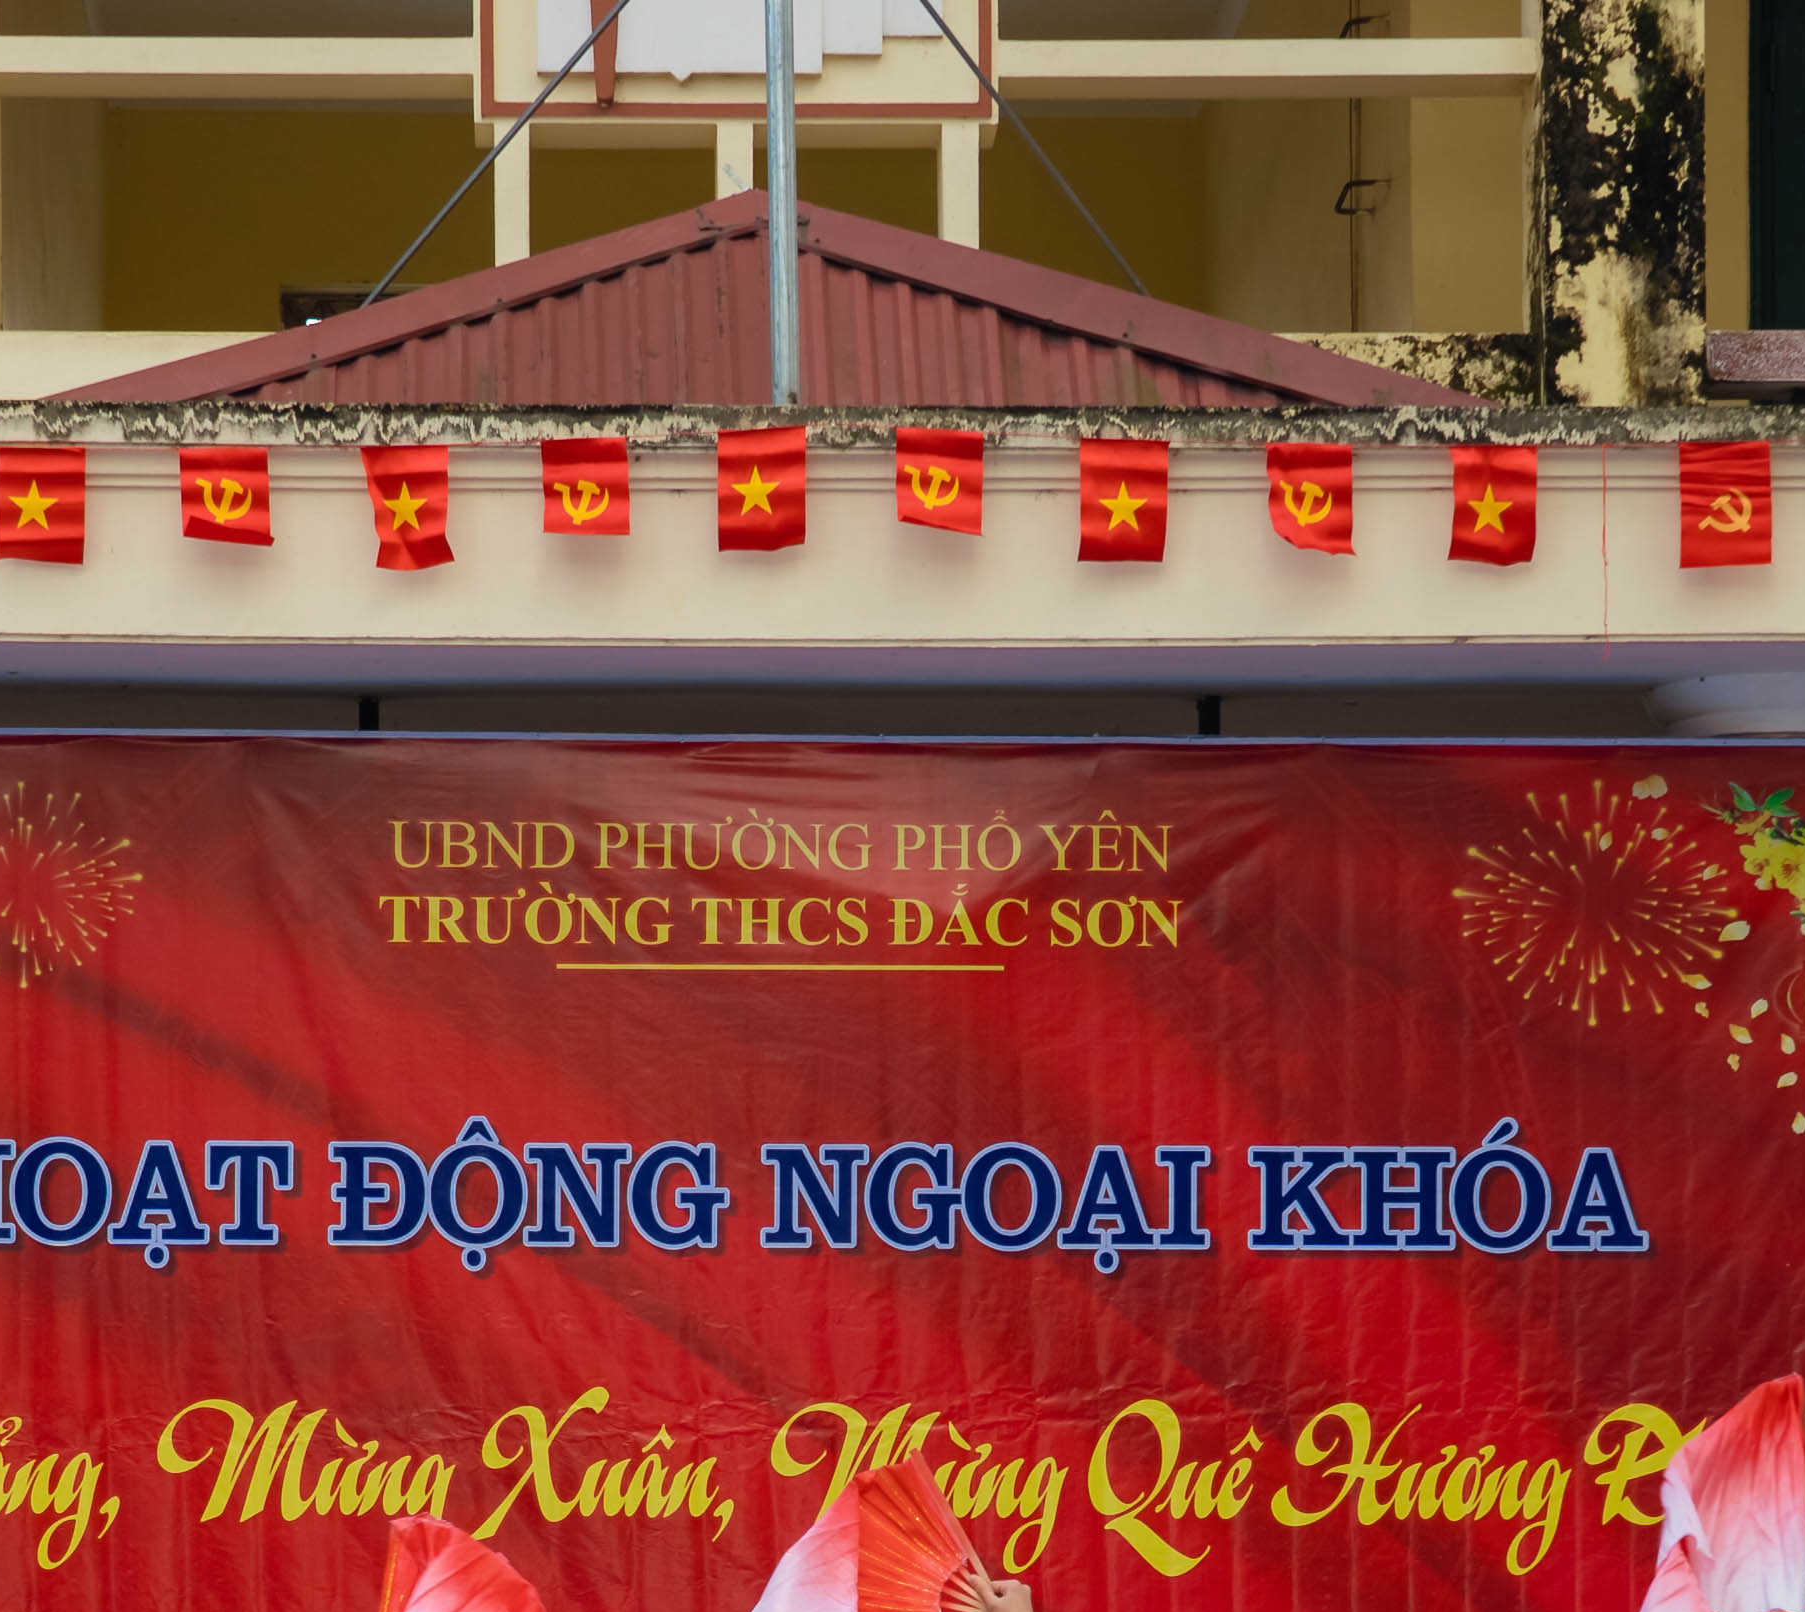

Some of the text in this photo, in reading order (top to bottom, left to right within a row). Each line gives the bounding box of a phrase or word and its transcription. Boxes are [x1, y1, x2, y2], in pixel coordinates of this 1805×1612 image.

[390, 807, 1171, 873] UBND PHƯỜNG PHỔ YÊN
[378, 882, 1182, 949] TRƯỜNG THCS ĐẮC SƠN
[328, 1115, 731, 1273] ĐỘNG
[760, 1140, 1212, 1275] NGOẠI
[1248, 1116, 1651, 1255] KHÓA
[480, 1386, 735, 1543] Xuân,
[1087, 1398, 1262, 1578] Quê
[1270, 1401, 1572, 1576] Hương
